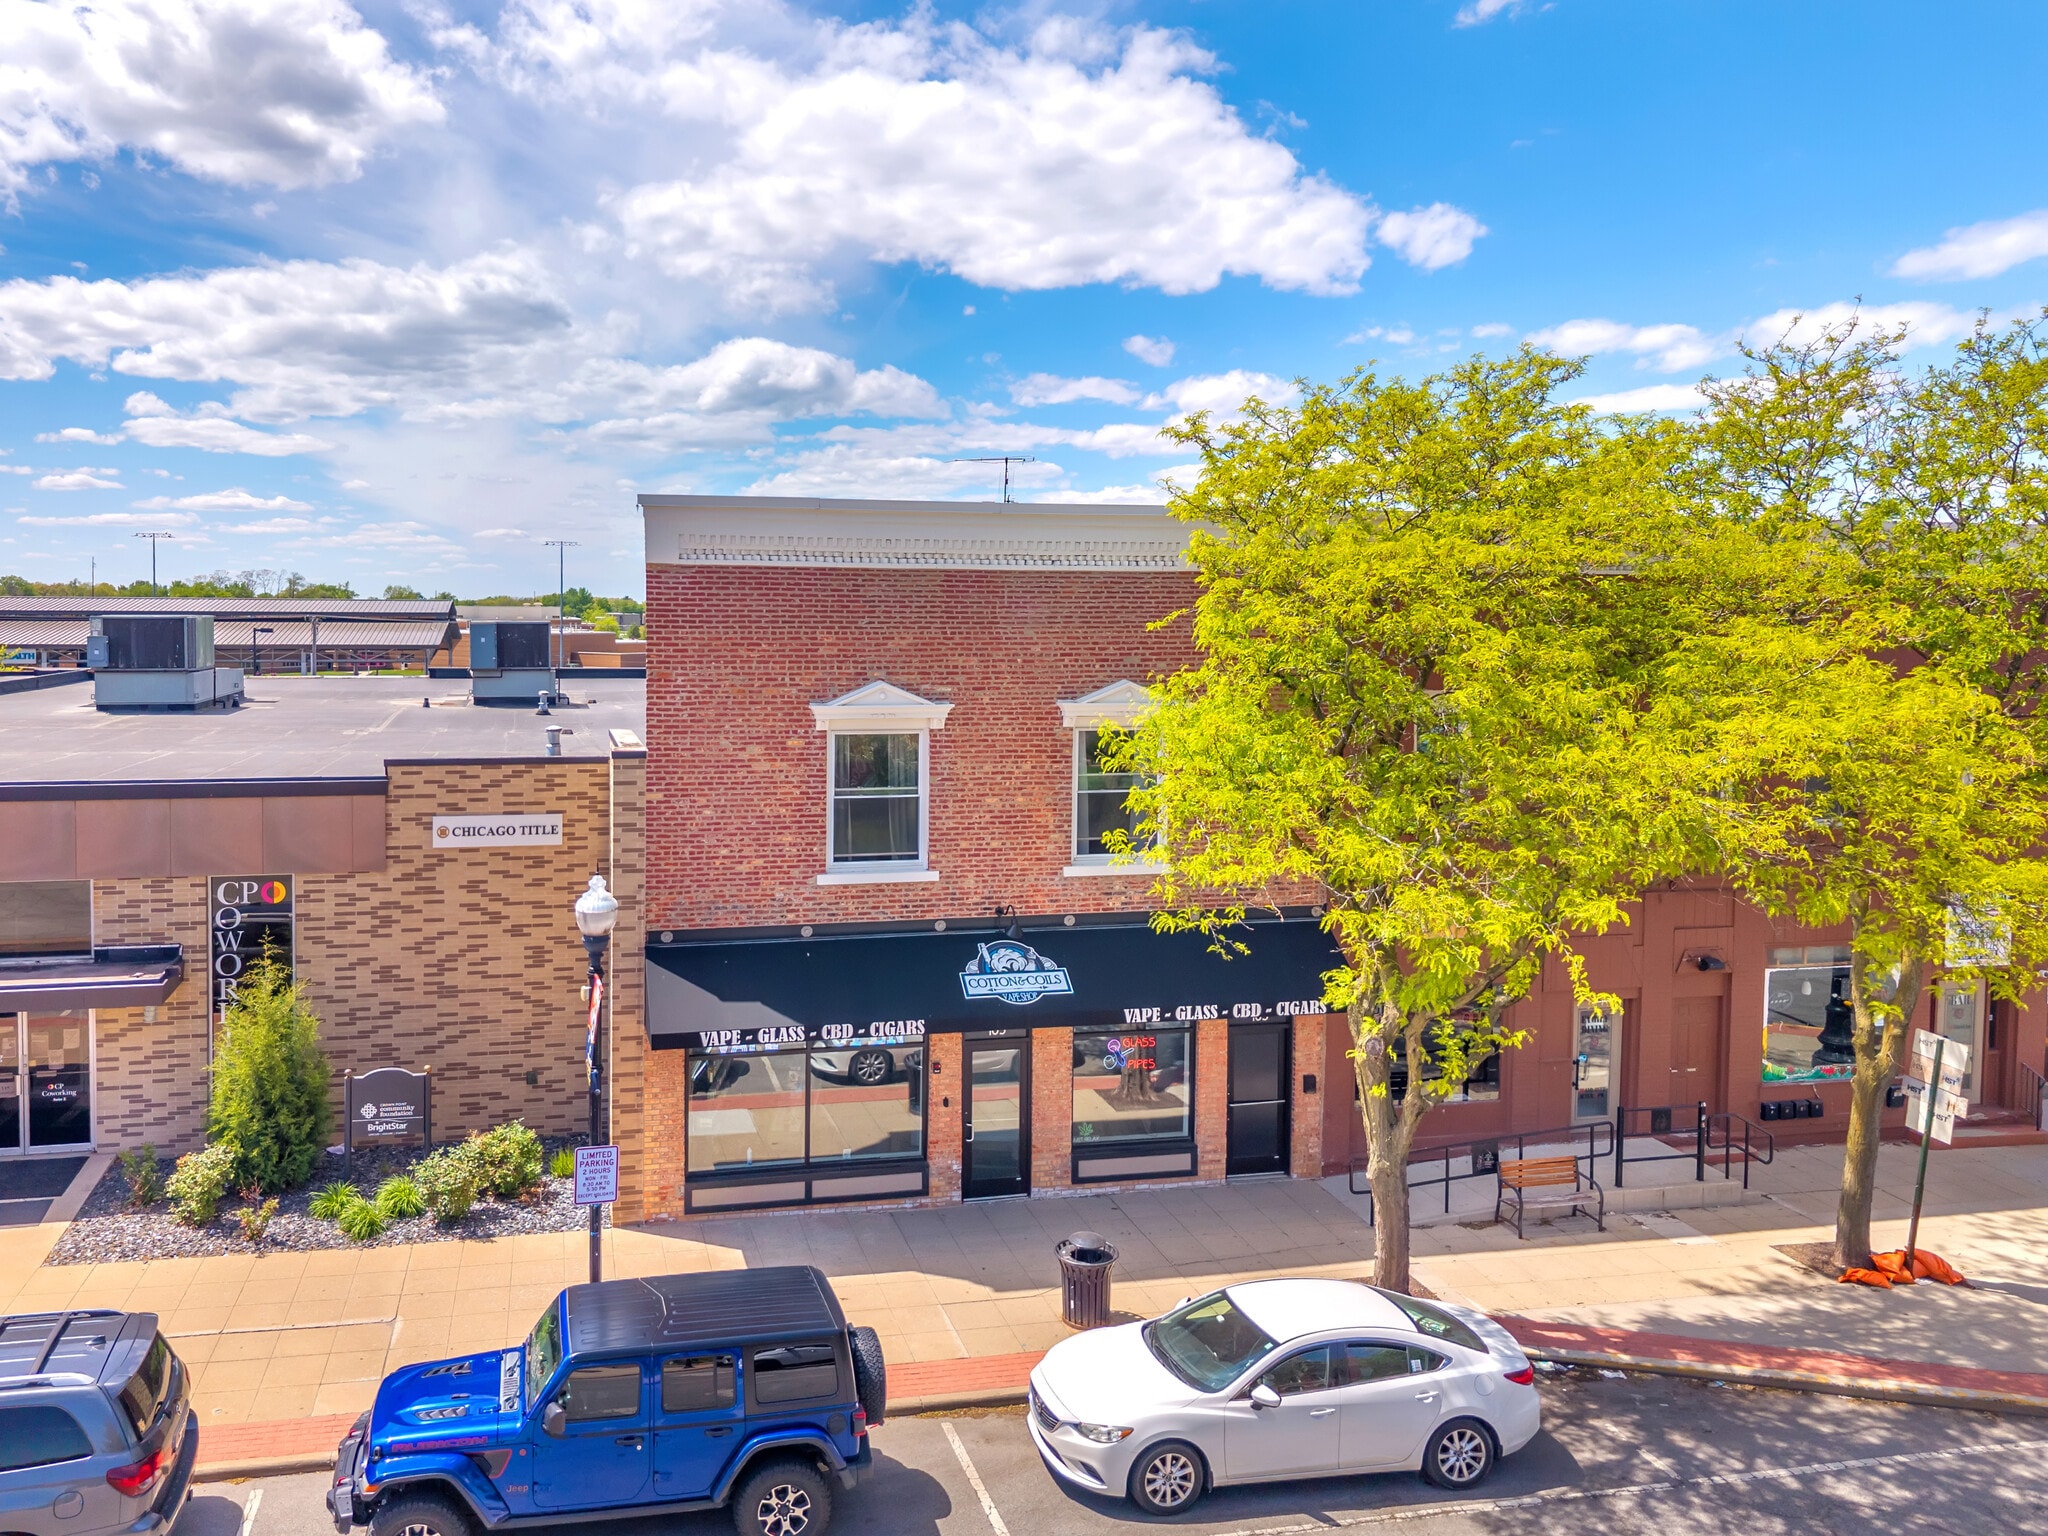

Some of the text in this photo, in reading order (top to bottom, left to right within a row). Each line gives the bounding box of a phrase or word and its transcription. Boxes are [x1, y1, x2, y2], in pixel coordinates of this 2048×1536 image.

[451, 824, 559, 838] CHICAGO TITLE
[1123, 1007, 1160, 1024] VAPE
[1175, 1004, 1218, 1021] GLASS
[1232, 1003, 1262, 1018] CBD
[1275, 1000, 1327, 1016] CIGARS
[699, 1030, 741, 1048] VAPE
[757, 1026, 806, 1044] GLASS
[821, 1023, 854, 1040] CBD
[869, 1019, 926, 1037] CIGARS
[1123, 1037, 1156, 1048] GLASS
[1127, 1058, 1156, 1070] PIPES
[41, 1089, 77, 1097] Coworking
[379, 1105, 415, 1113] community
[367, 1121, 408, 1133] BrightStar
[581, 1151, 612, 1160] LIMITED
[579, 1159, 614, 1168] PARKING
[589, 1167, 611, 1175] HOURS
[391, 1436, 488, 1453] RUBICON
[506, 1484, 529, 1493] Jeep
